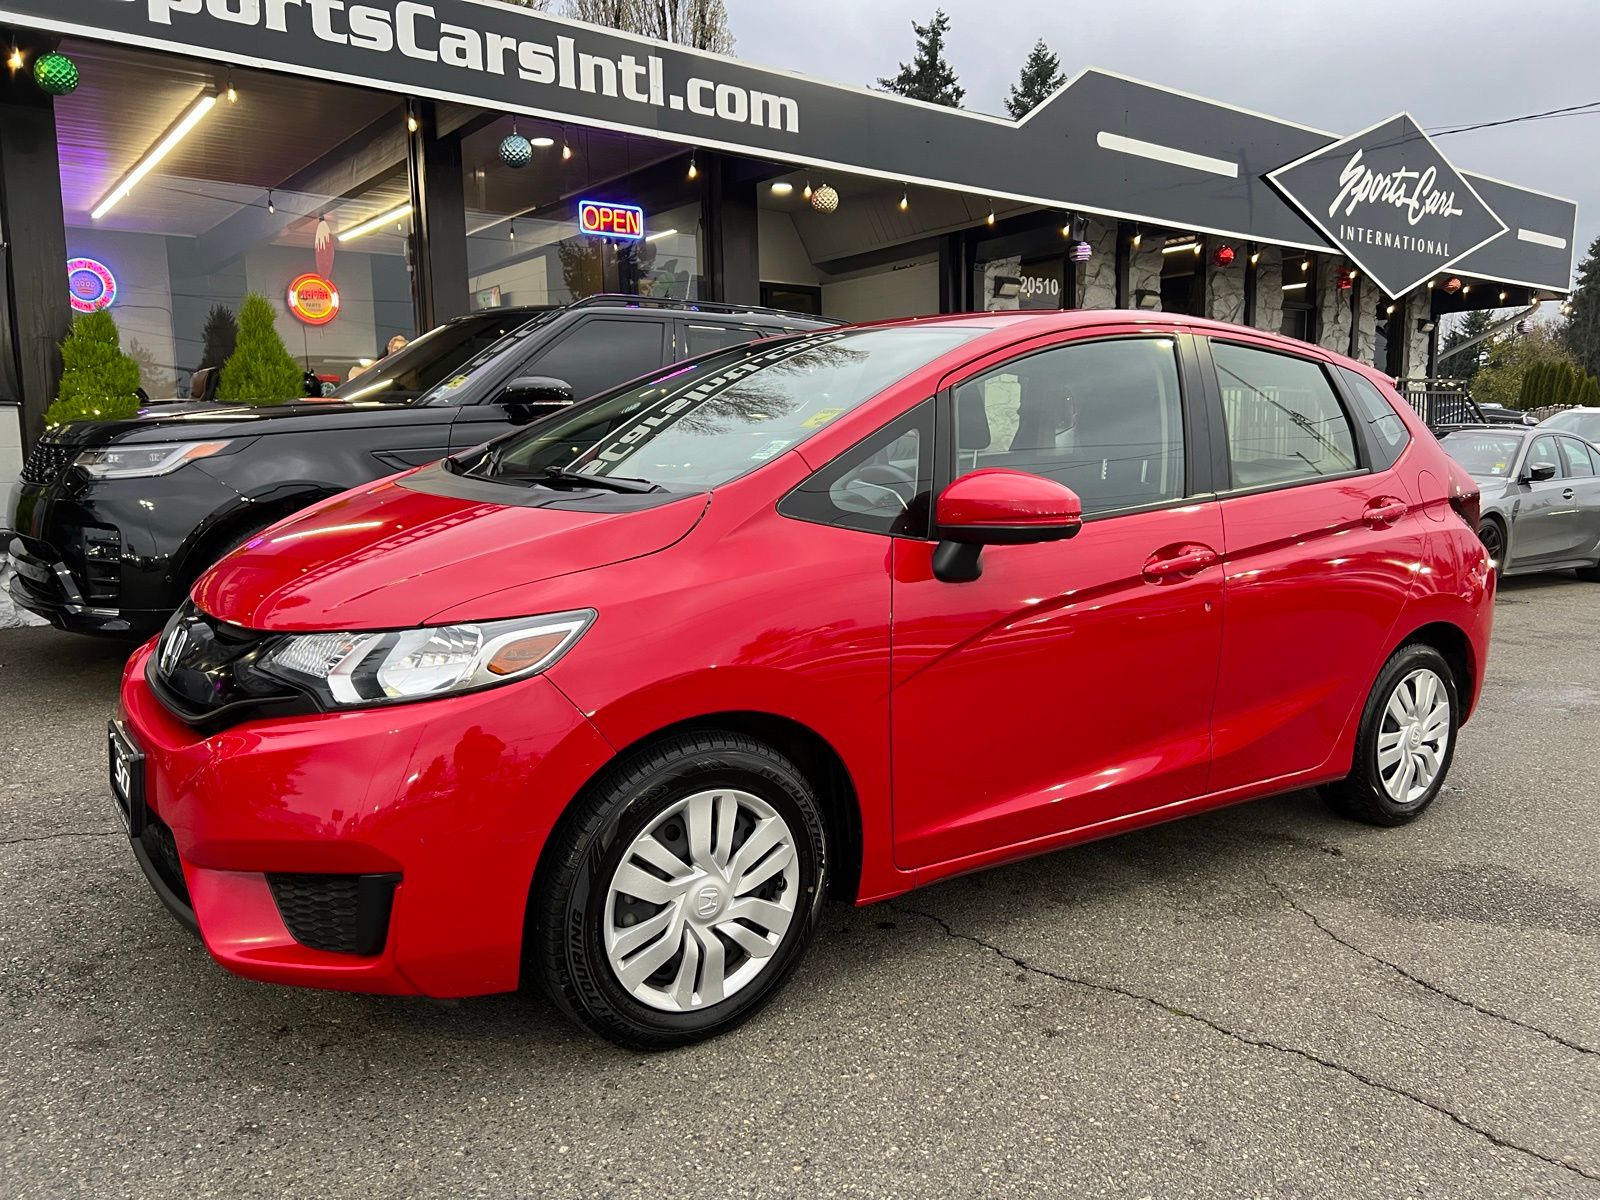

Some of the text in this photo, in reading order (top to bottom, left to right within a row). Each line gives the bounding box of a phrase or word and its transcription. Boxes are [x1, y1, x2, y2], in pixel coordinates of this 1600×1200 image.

[120, 0, 799, 134] ortsCarsIntl.com
[583, 205, 640, 235] OPEN
[1339, 224, 1450, 257] INTERNATIONAL
[1020, 276, 1059, 296] 20510
[569, 908, 600, 1004] TOURING
